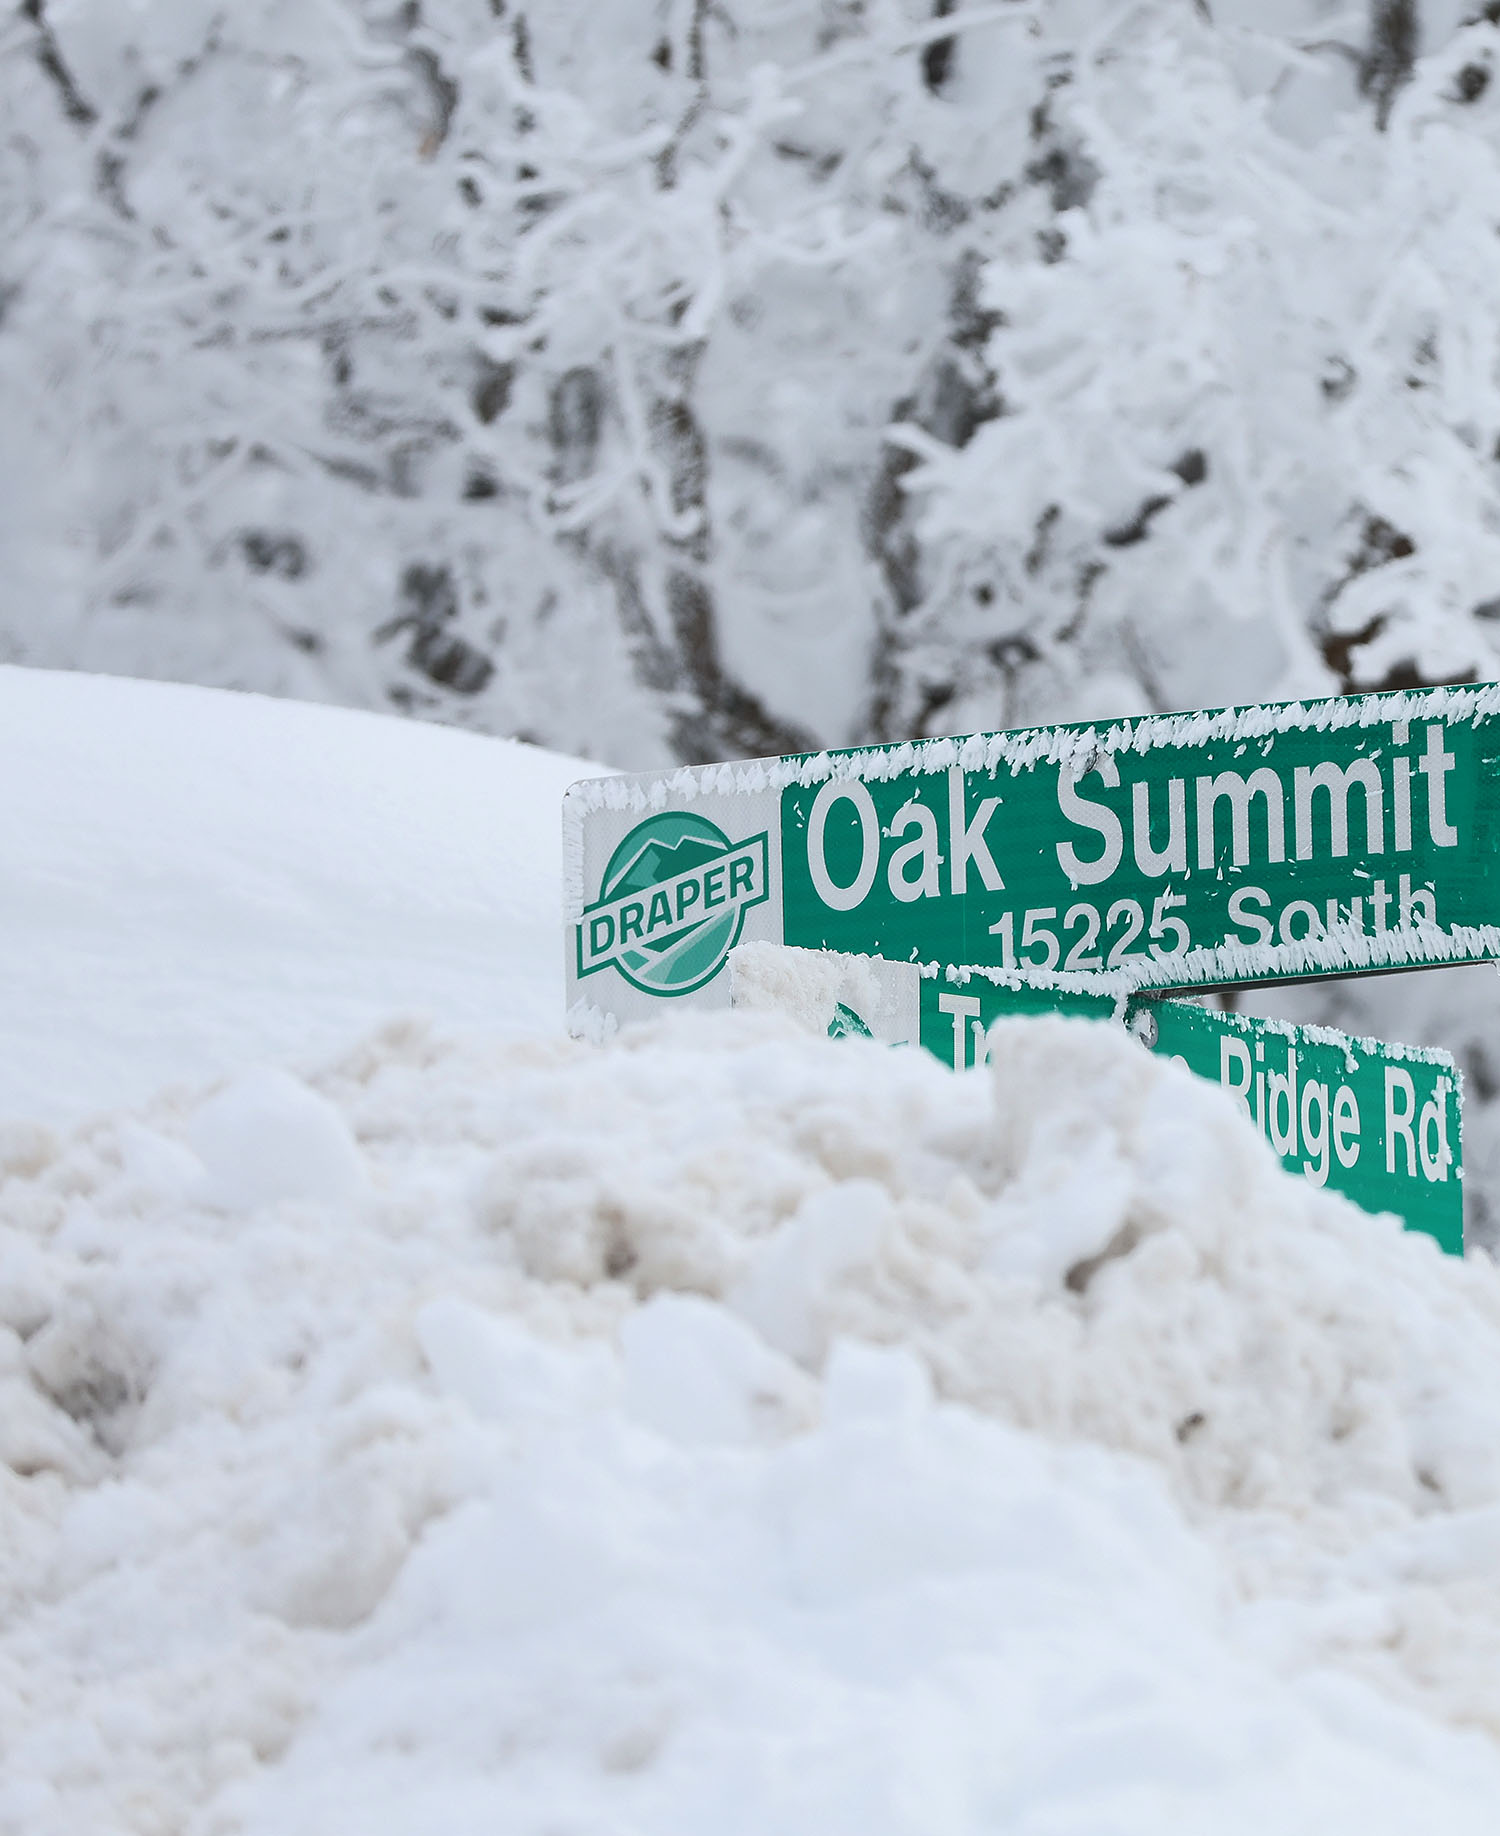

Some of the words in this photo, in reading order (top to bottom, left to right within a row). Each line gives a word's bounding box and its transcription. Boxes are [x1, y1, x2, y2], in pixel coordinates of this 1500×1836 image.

[806, 765, 1006, 912] Oak
[1056, 724, 1457, 885] Summit
[589, 855, 755, 957] DRAPER
[988, 896, 1191, 972] 15225
[1227, 875, 1437, 948] South
[1220, 1035, 1361, 1187] Ridge
[1385, 1066, 1452, 1183] Rd
